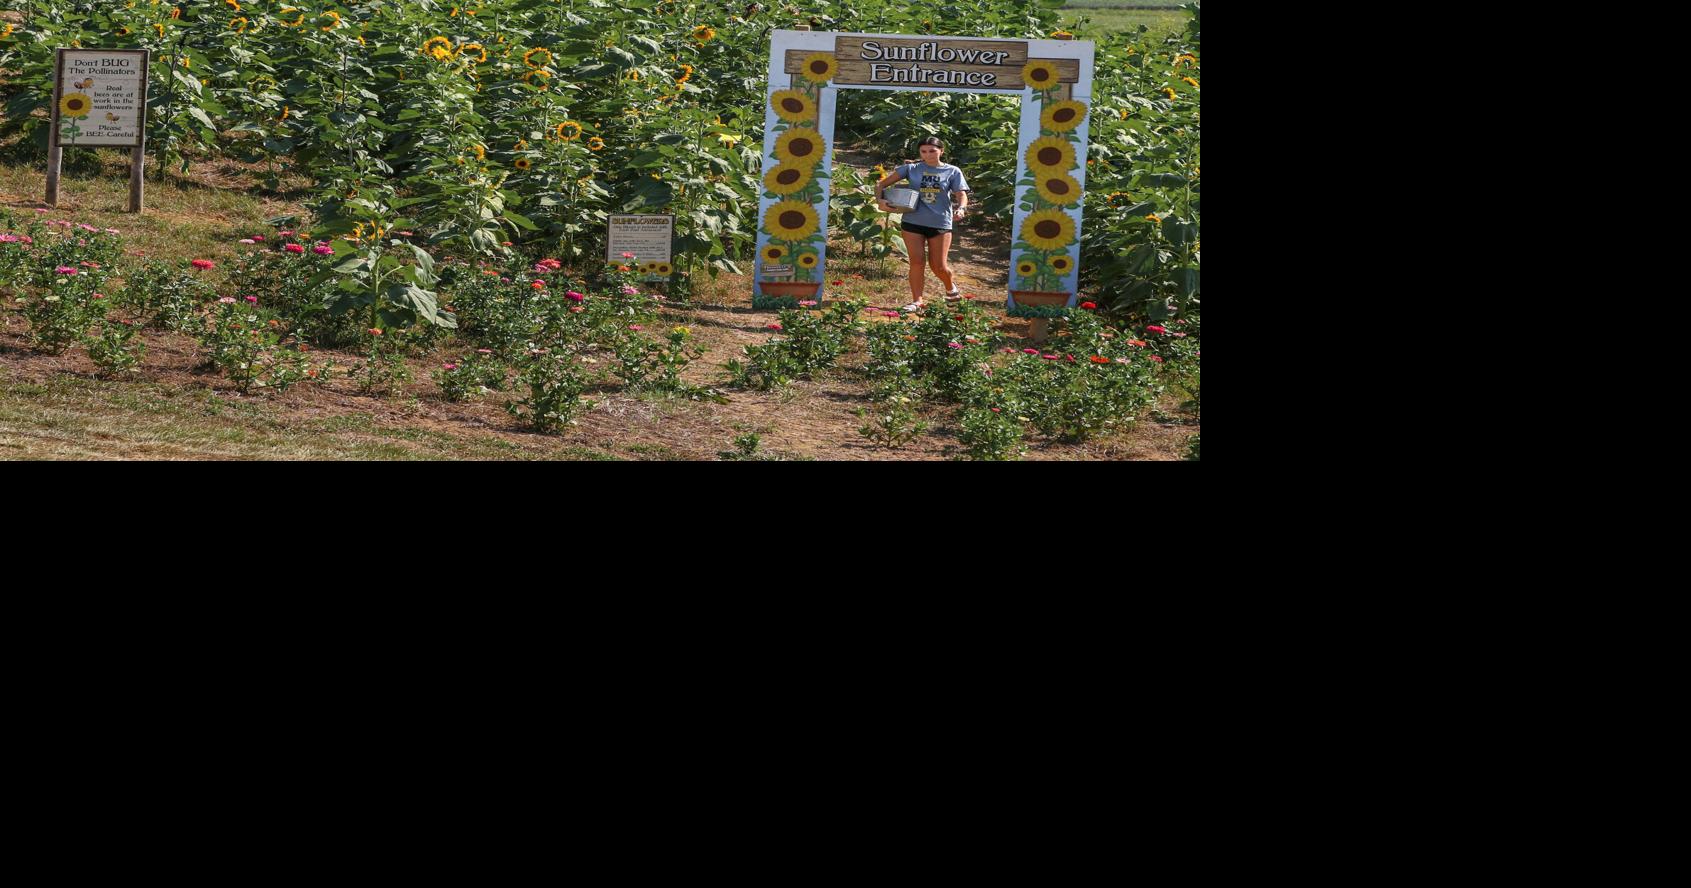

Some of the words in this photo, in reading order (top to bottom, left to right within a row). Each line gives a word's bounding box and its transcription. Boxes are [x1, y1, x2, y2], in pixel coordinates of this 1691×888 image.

[861, 41, 1009, 65] Sunflower
[101, 58, 129, 67] BUG
[88, 67, 136, 75] Pollinators
[869, 63, 996, 86] Entrance
